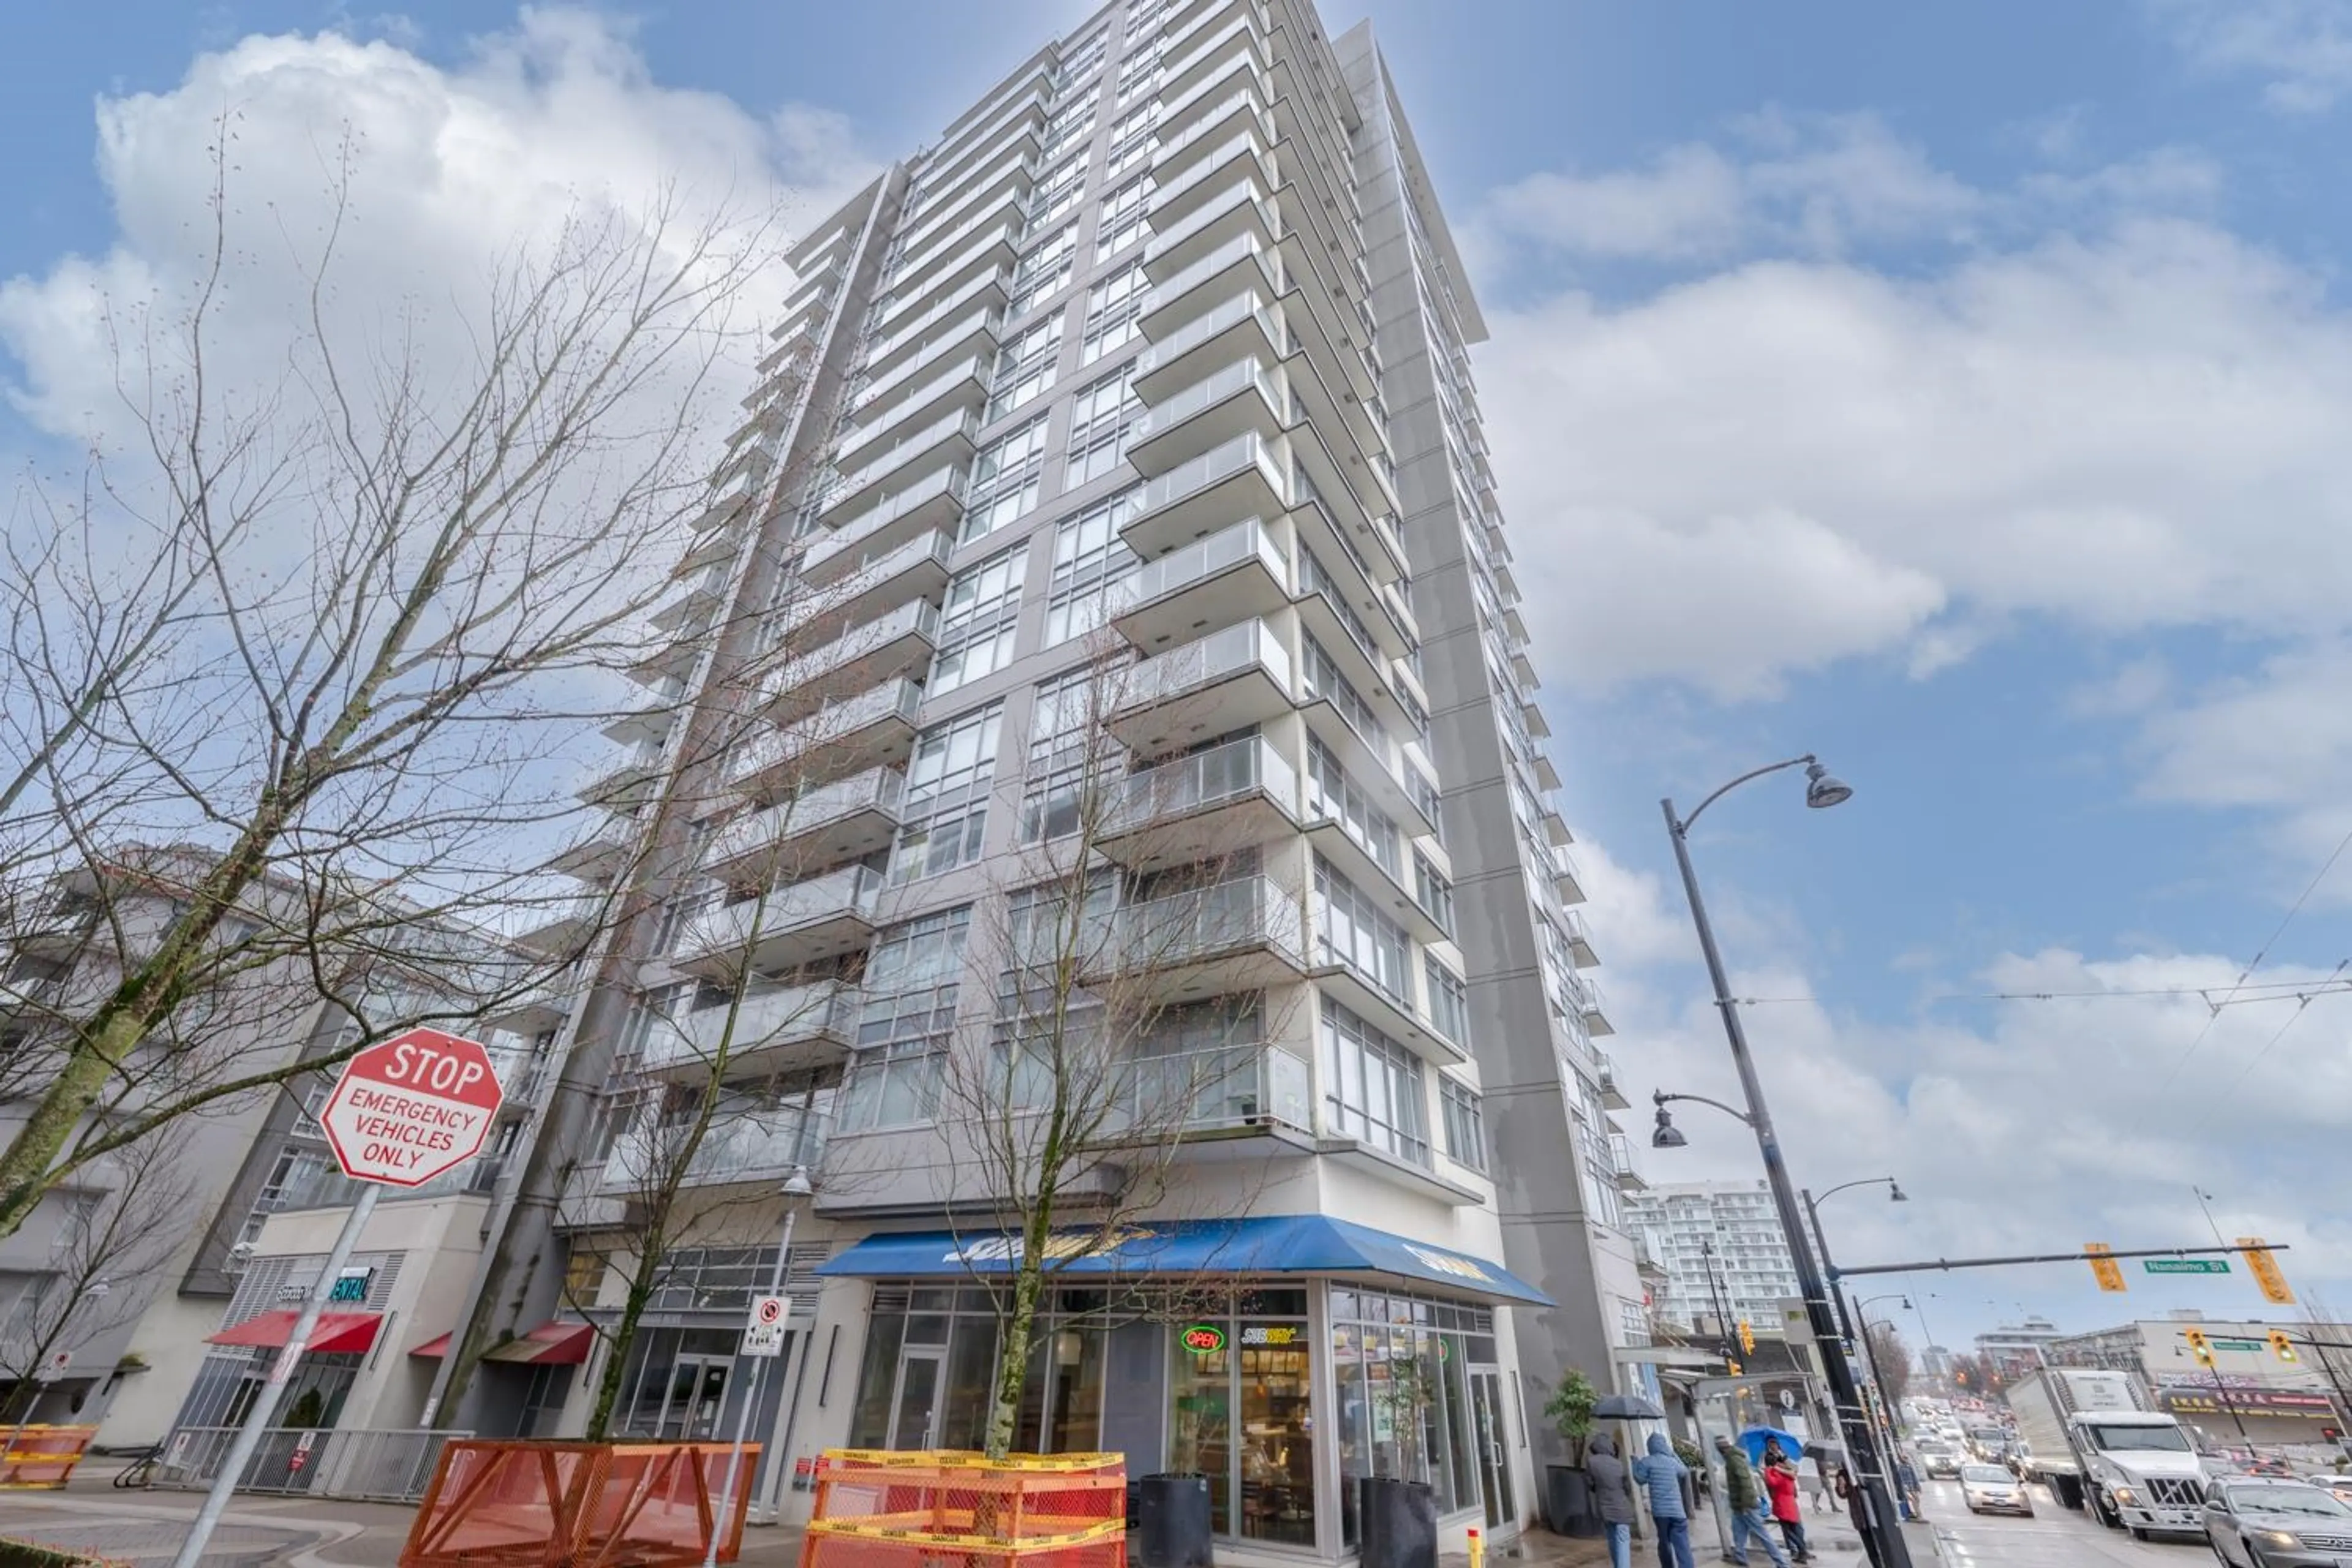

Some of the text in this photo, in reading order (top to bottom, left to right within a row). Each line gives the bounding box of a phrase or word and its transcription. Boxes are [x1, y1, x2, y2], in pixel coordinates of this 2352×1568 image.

[385, 1043, 484, 1095] STOP
[349, 1088, 477, 1131] EMERGENCY
[355, 1114, 454, 1150] VEHICLES
[363, 1143, 424, 1169] ONLY
[330, 1277, 366, 1301] ENTAL
[1186, 1331, 1219, 1348] OPEN
[1240, 1327, 1296, 1344] SUBWAY
